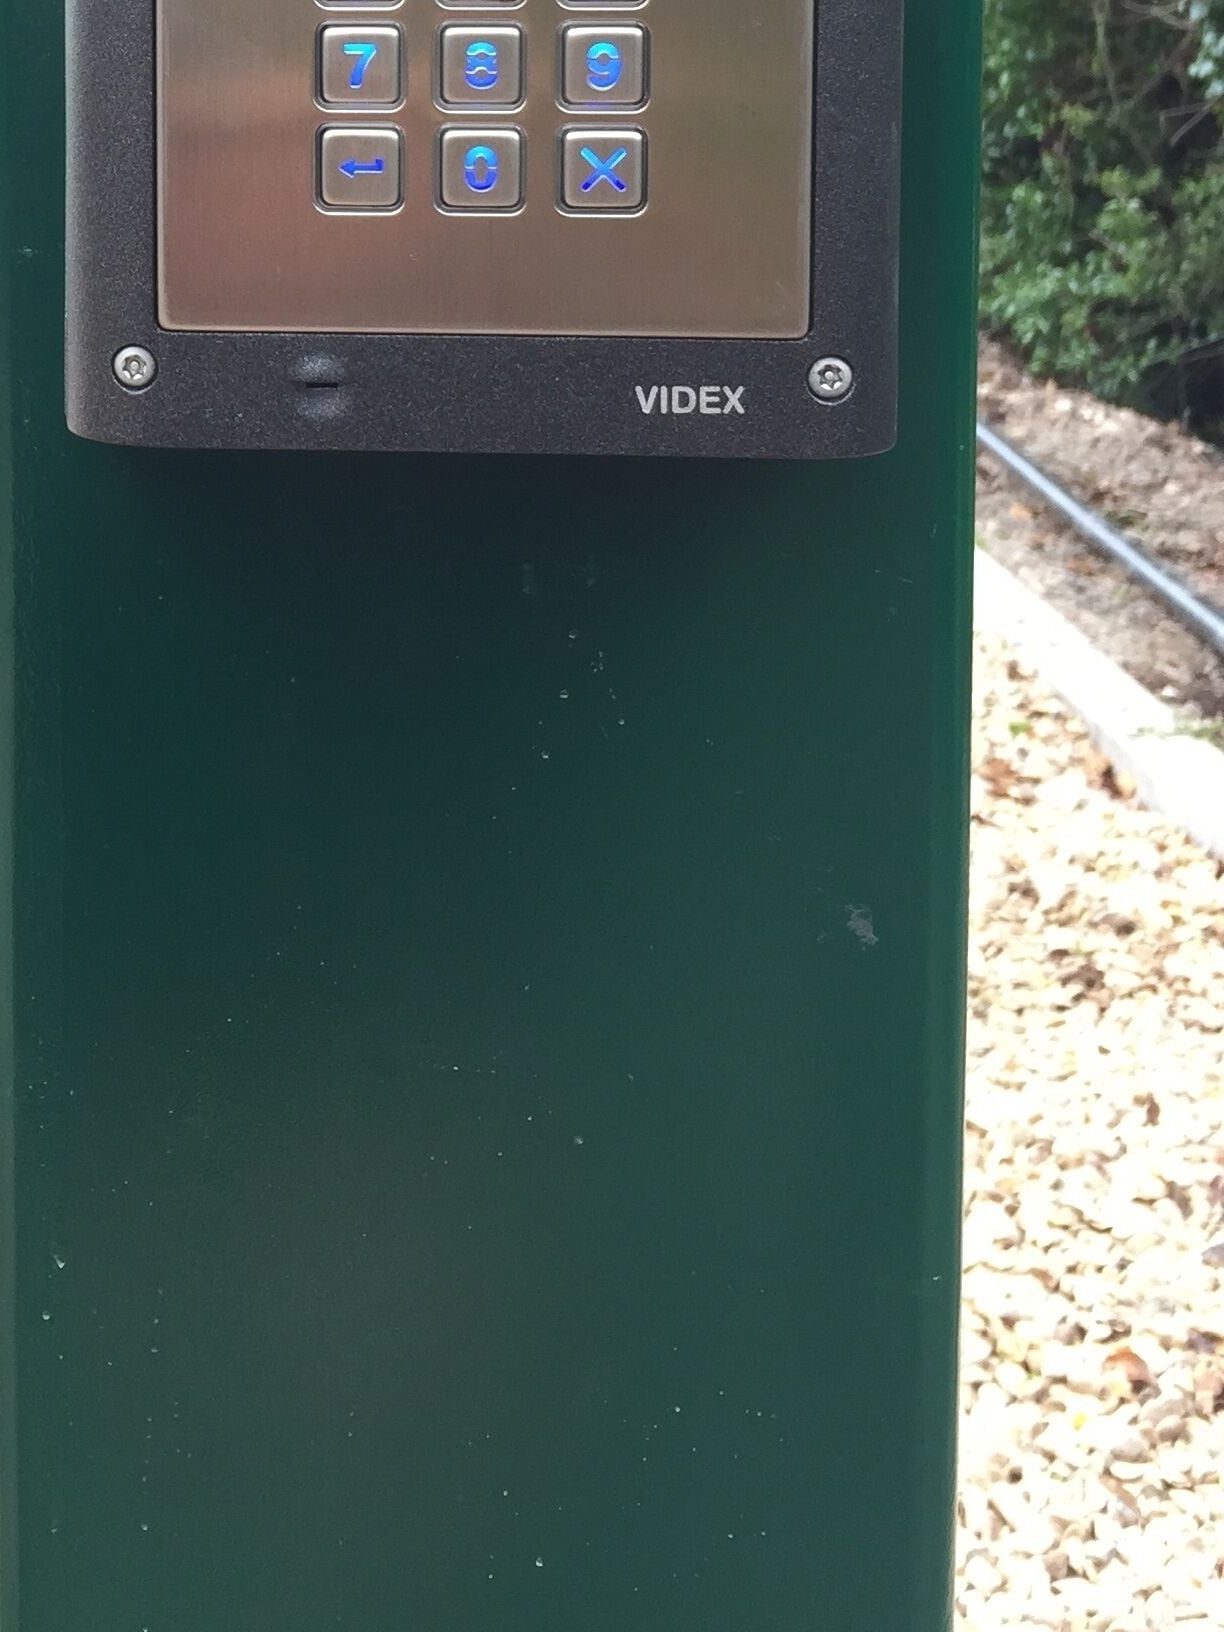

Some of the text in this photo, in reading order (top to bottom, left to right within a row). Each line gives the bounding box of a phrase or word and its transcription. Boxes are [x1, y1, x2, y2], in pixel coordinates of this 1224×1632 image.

[343, 42, 377, 88] 7
[465, 41, 498, 89] 8
[586, 42, 622, 91] 9
[464, 145, 499, 192] 0
[634, 385, 745, 414] VIDEX
